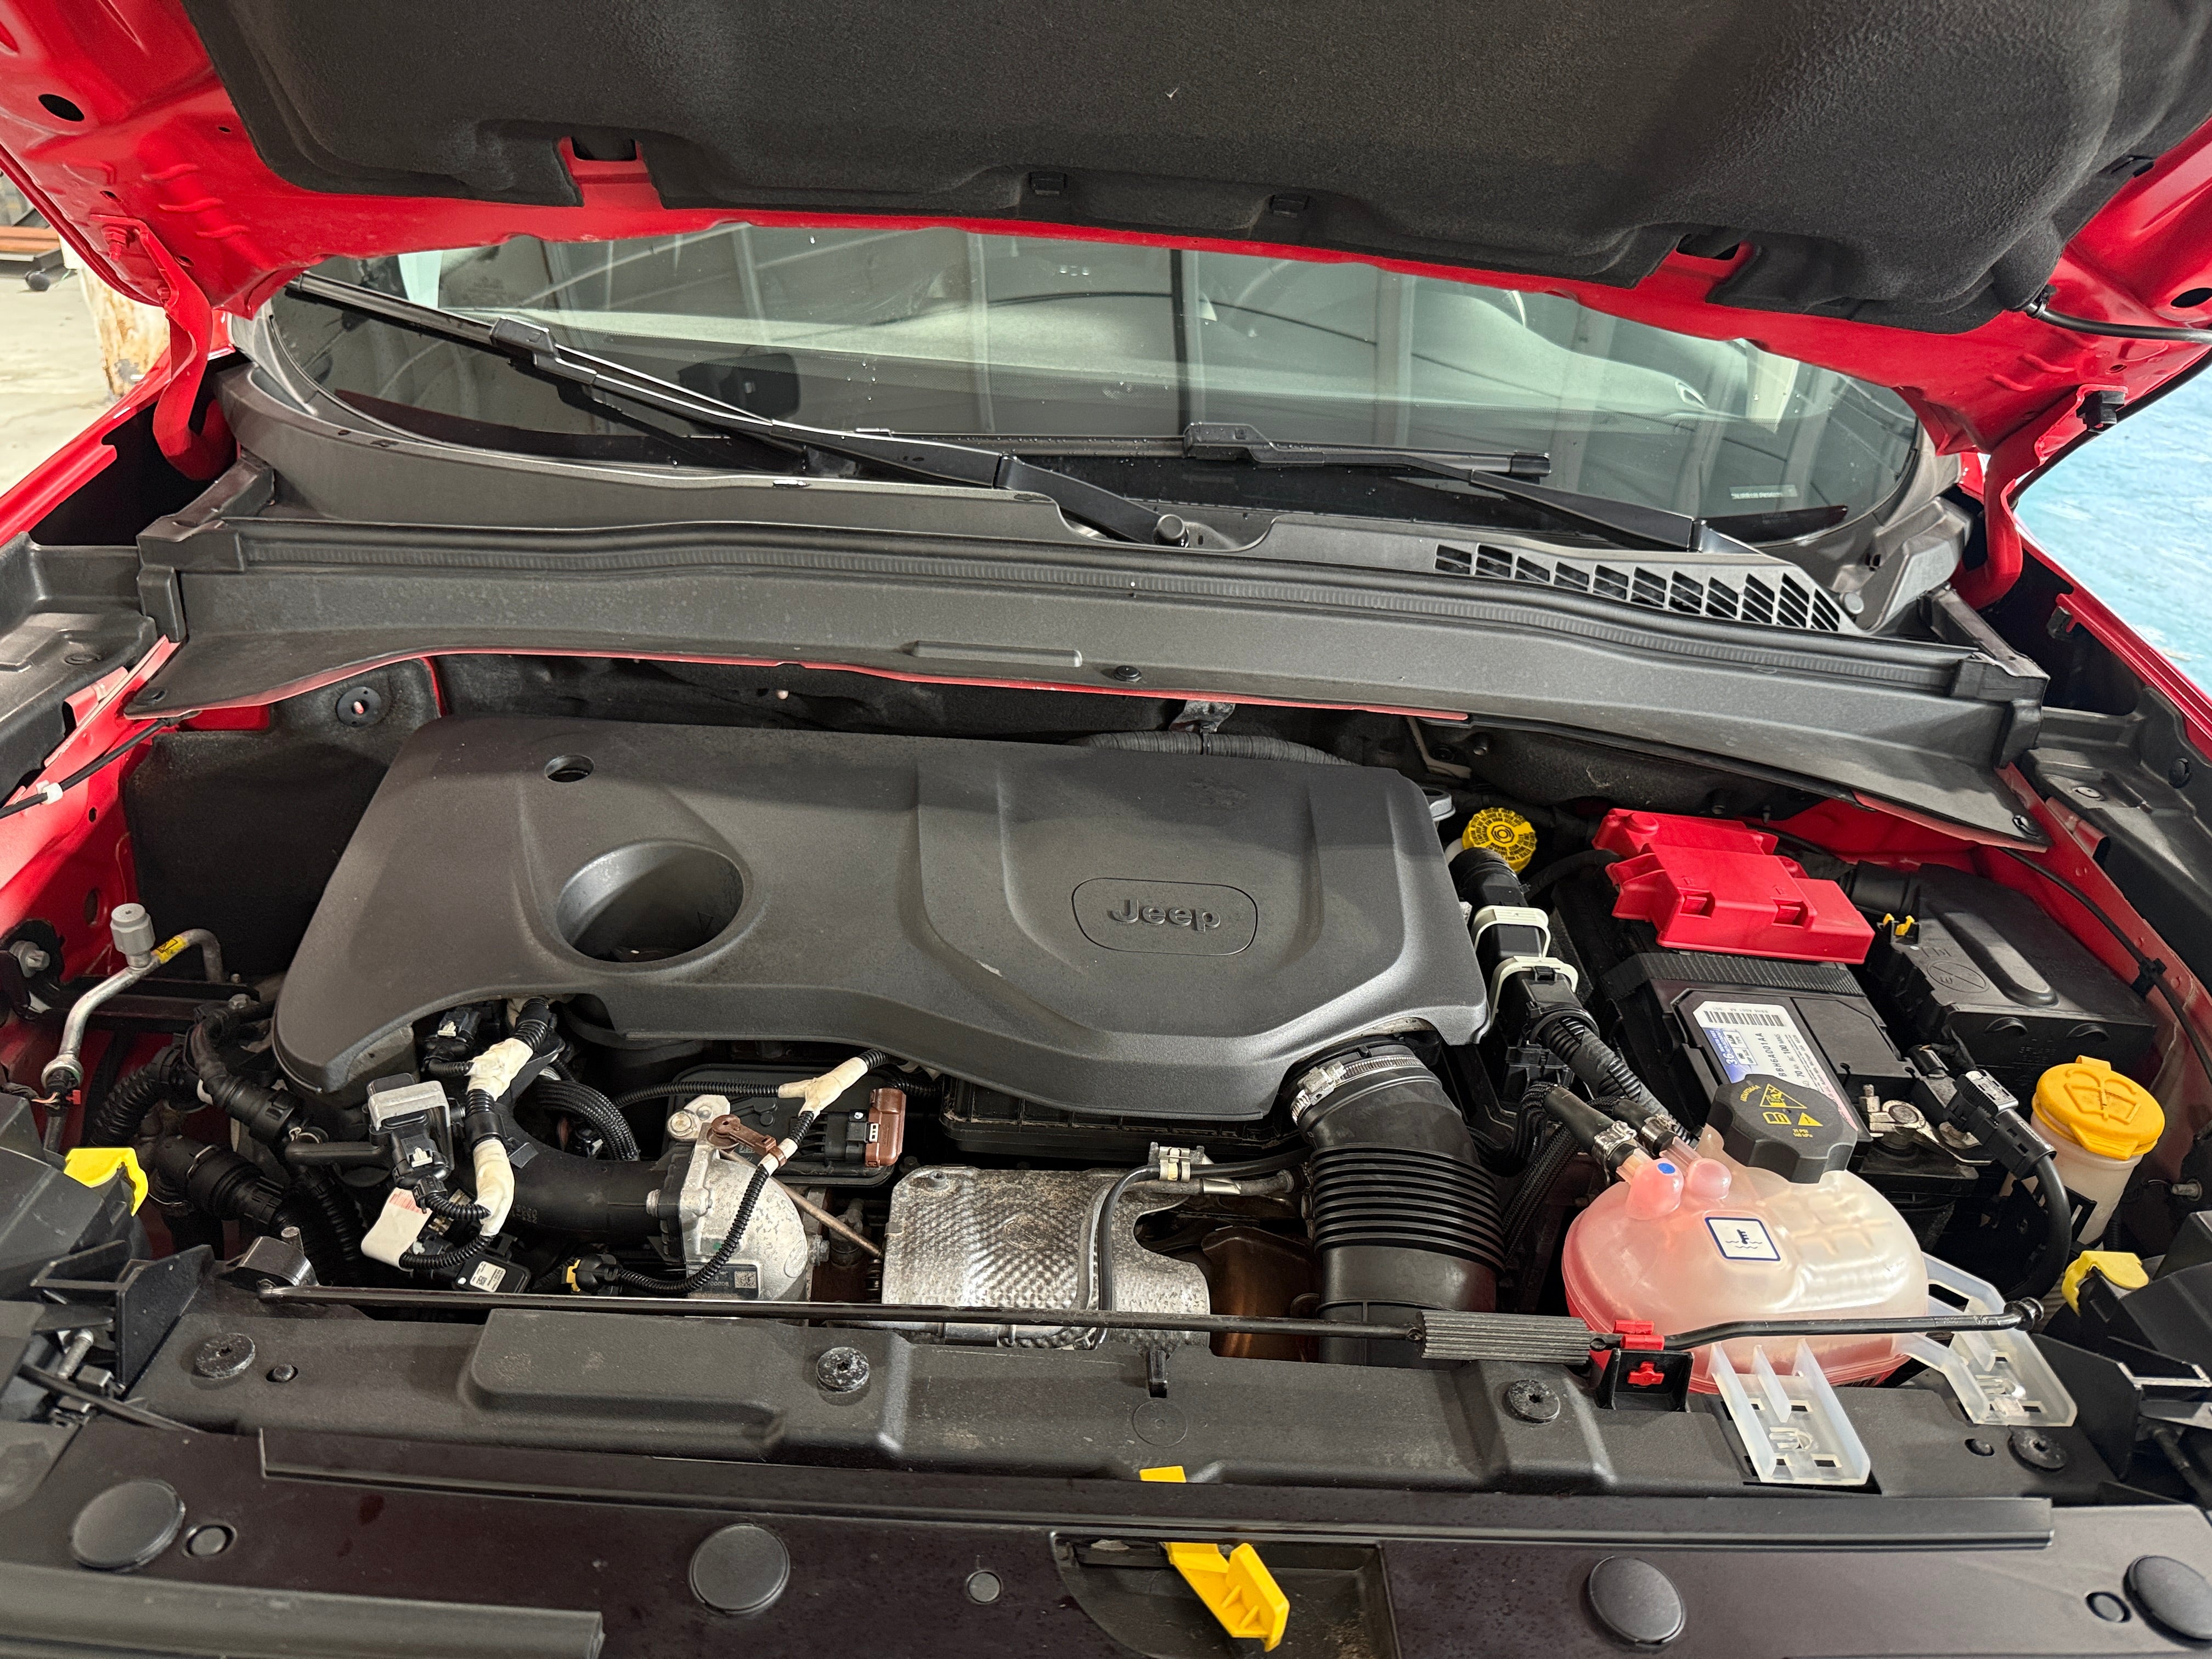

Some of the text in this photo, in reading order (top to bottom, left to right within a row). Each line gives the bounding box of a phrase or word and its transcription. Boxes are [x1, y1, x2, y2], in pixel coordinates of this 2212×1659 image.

[1108, 898, 1221, 932] Jeep
[1779, 1045, 1791, 1054] 100
[1722, 1052, 1739, 1065] 36
